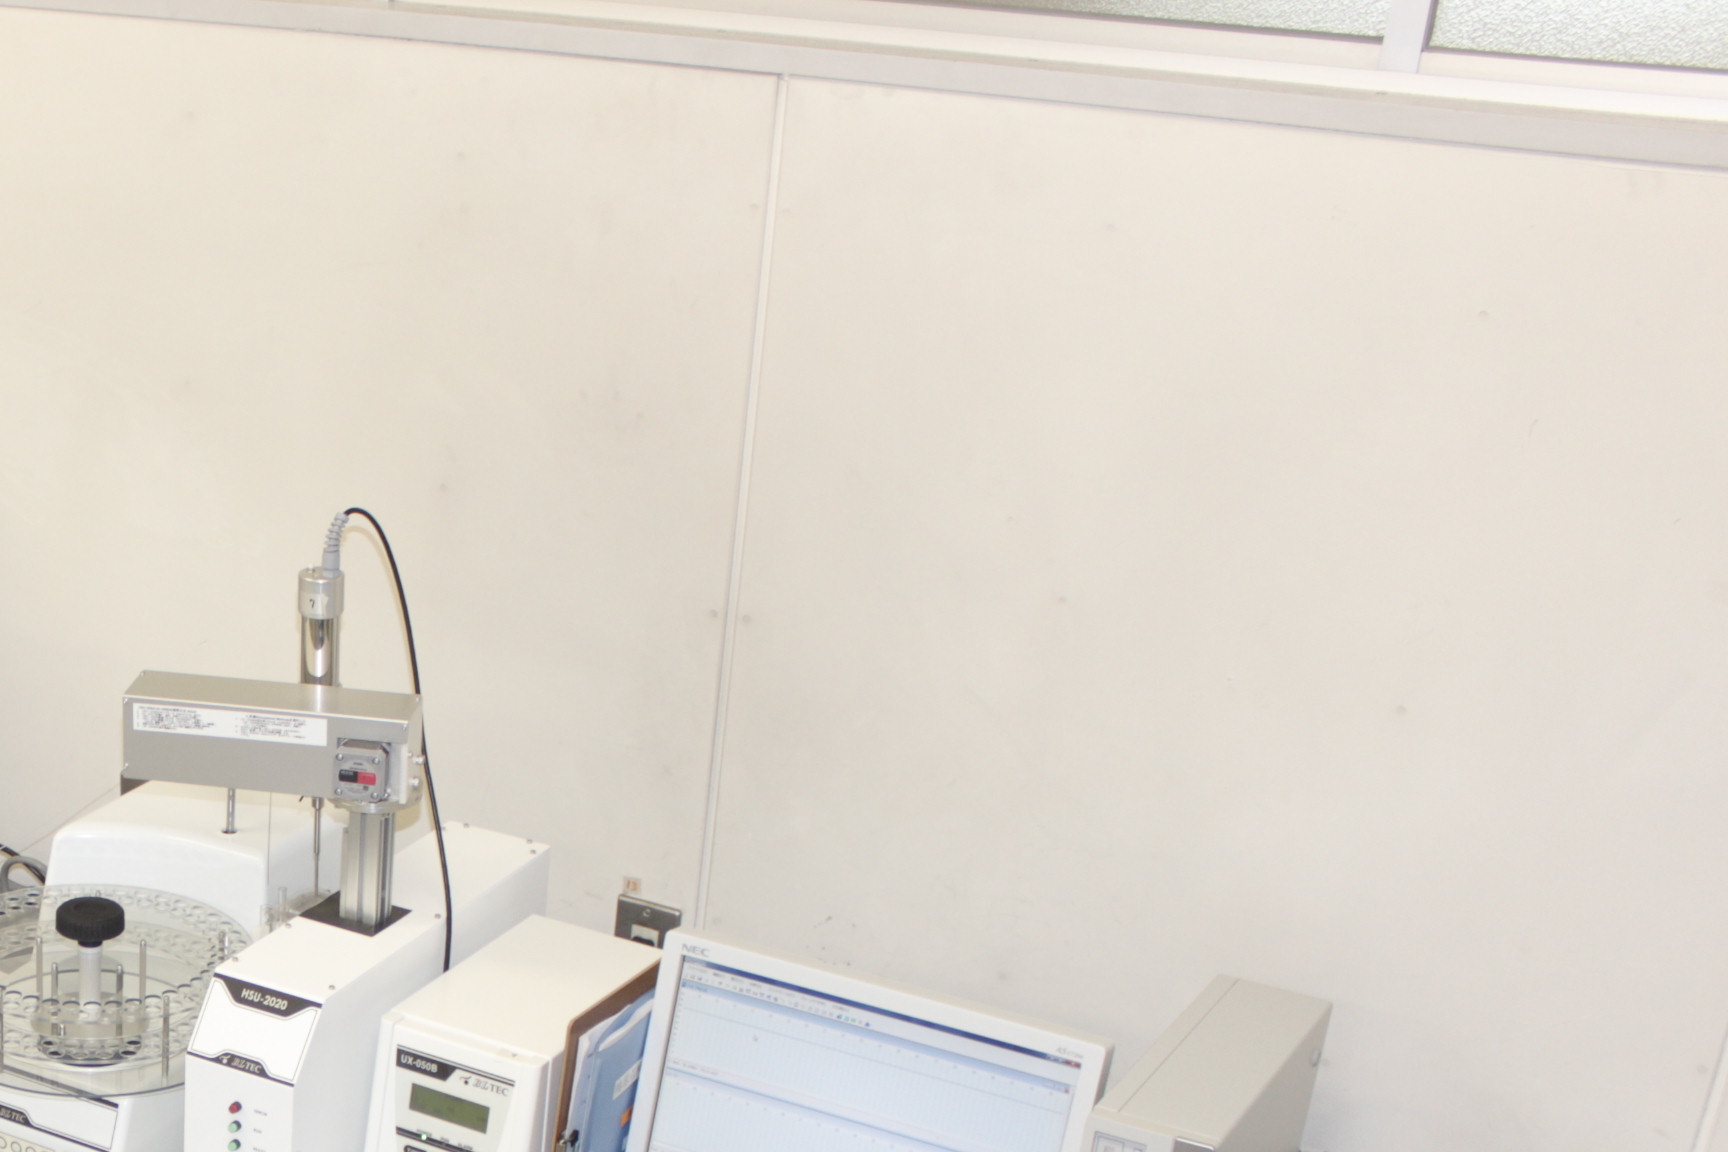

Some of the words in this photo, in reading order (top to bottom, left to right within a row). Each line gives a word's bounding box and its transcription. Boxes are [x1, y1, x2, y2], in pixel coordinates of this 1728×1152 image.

[682, 943, 710, 957] NEC
[241, 988, 288, 1010] HSU-2020
[400, 1054, 438, 1073] UX-050B
